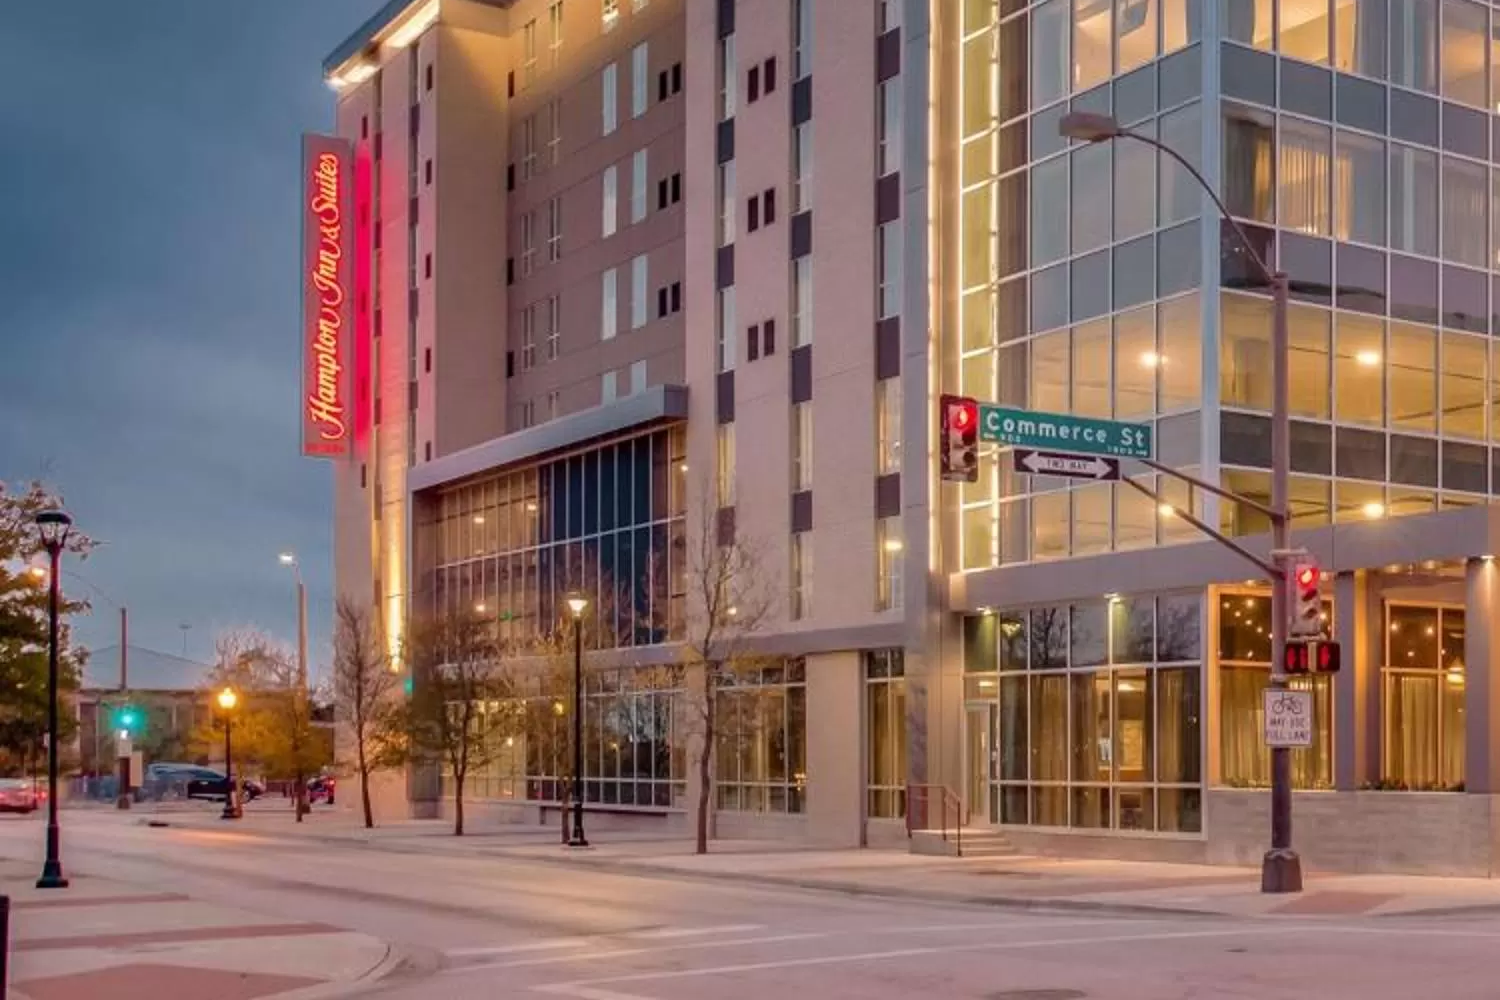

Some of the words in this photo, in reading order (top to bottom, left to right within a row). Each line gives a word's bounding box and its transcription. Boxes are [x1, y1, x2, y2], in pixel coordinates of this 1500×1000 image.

[311, 153, 340, 226] Suites
[312, 239, 342, 306] Inn
[308, 307, 345, 440] Hampton
[986, 412, 1108, 444] Commerce
[1119, 427, 1145, 448] St
